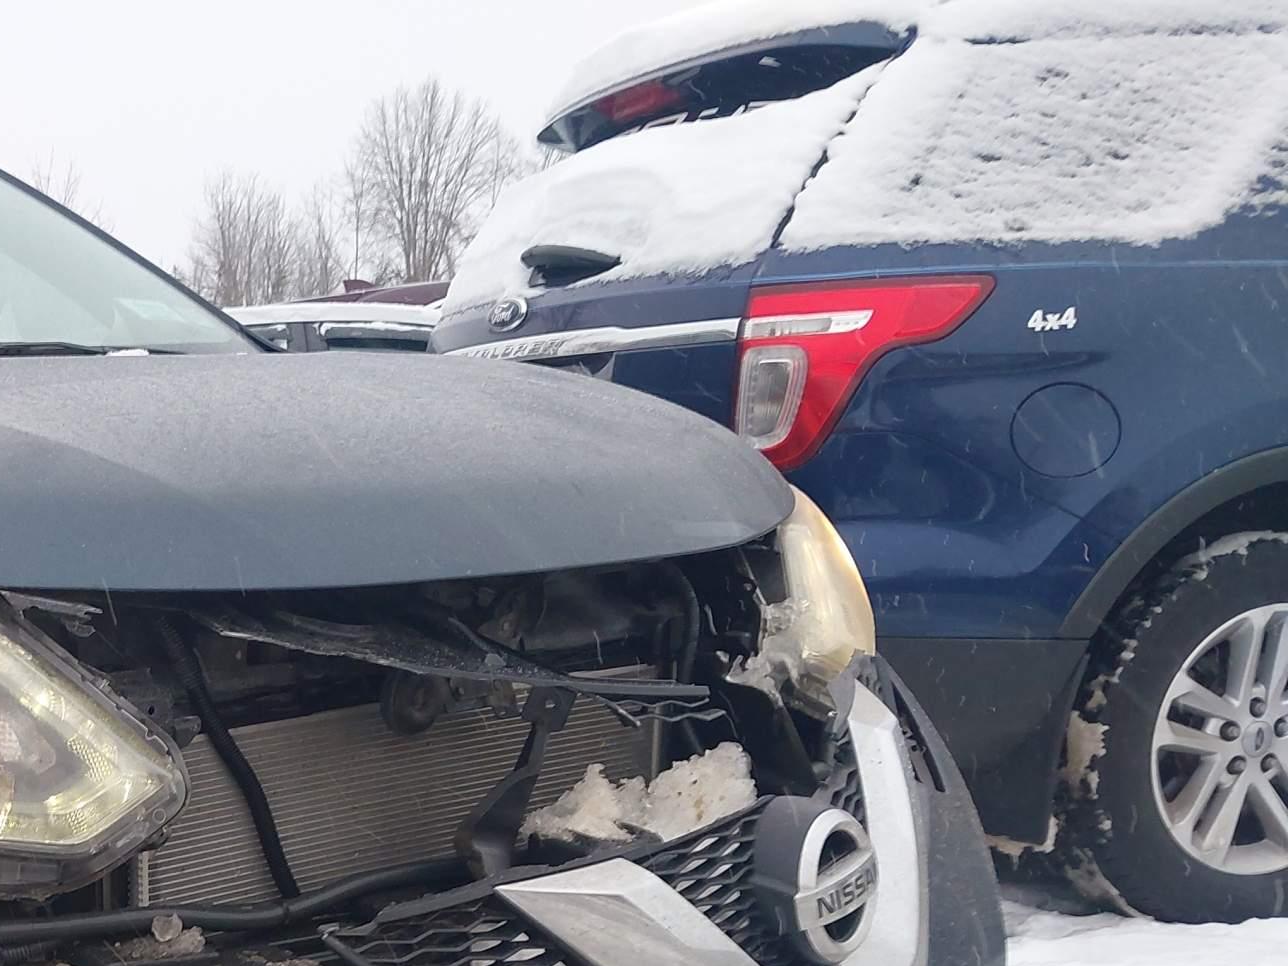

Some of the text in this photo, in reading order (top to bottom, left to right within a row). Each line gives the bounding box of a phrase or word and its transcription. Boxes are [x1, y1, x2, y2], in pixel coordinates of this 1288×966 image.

[1027, 306, 1078, 332] 4x4
[462, 338, 567, 360] PLORER
[816, 862, 877, 919] NISSA
